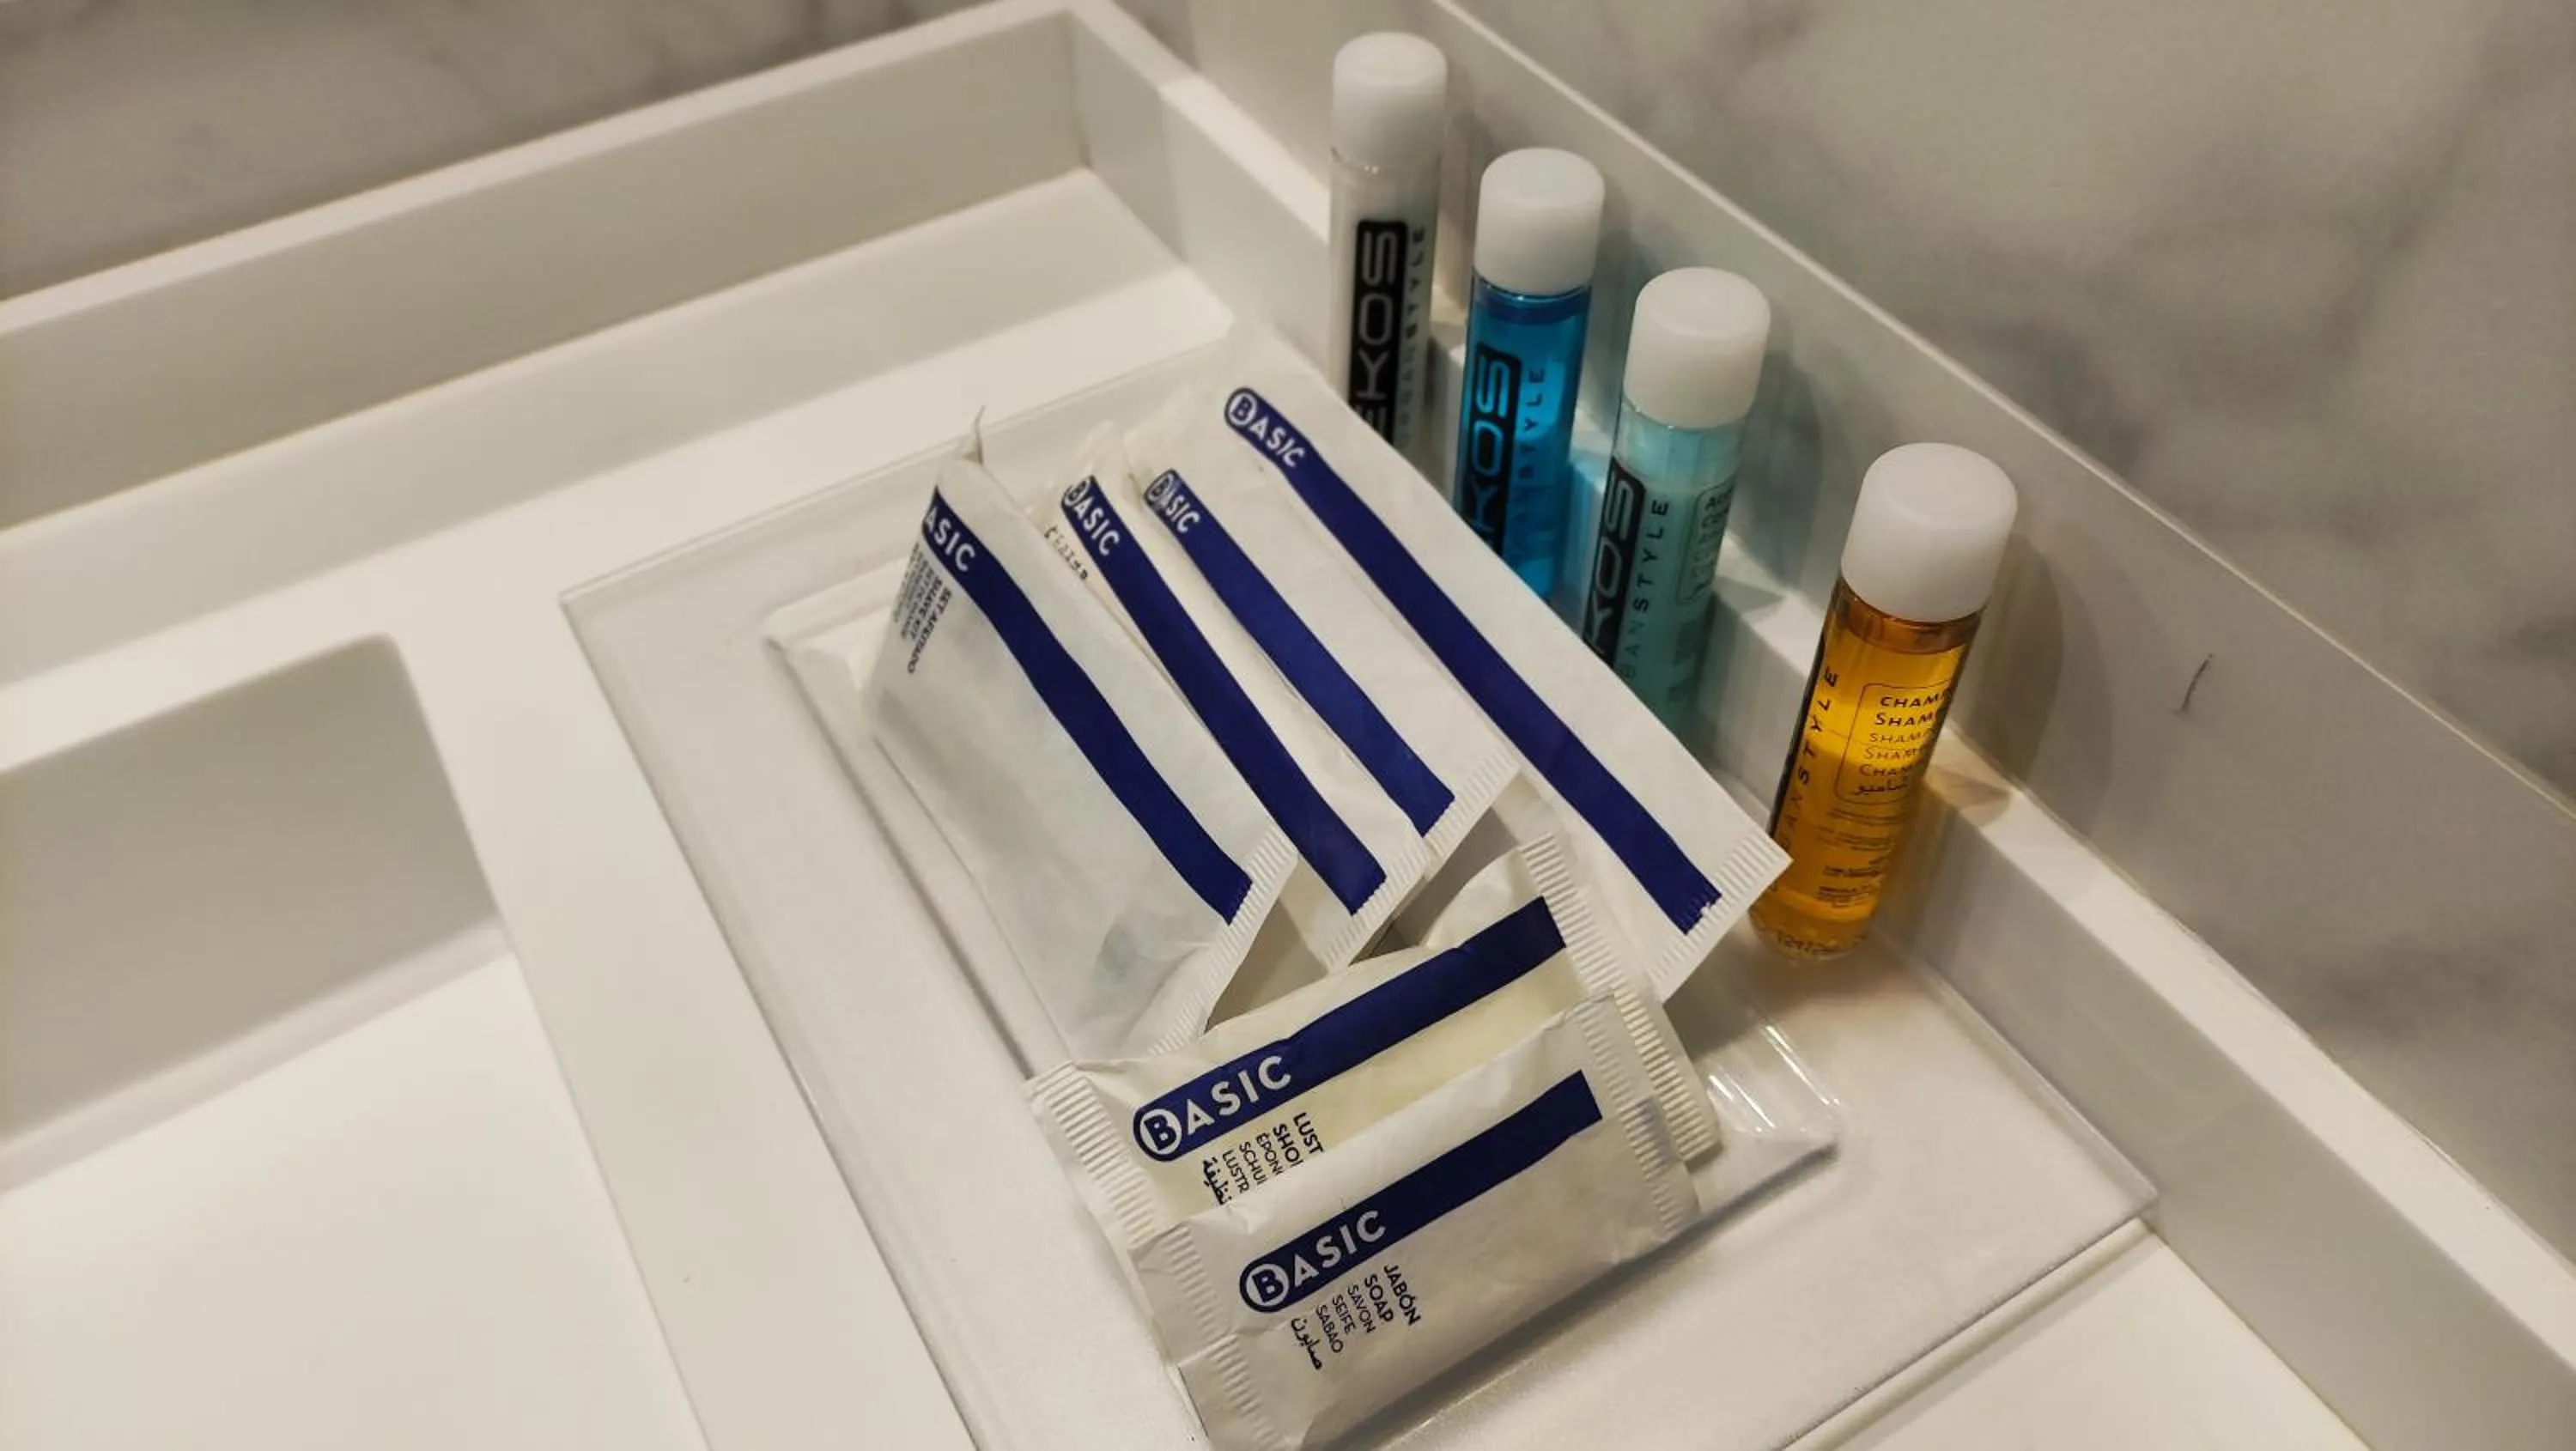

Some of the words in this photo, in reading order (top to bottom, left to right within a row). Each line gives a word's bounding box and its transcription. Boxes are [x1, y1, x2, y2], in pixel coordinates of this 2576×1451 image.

[1228, 392, 1305, 468] BASIC
[1467, 353, 1510, 534] KOS
[1062, 477, 1120, 556] BASIC
[1144, 472, 1200, 533] BASIC
[925, 505, 975, 572] ASIC
[1592, 472, 1635, 656] KOS
[1874, 711, 1937, 726] SHAM
[1139, 1054, 1291, 1157] BASIC
[1245, 1210, 1387, 1314] BASIC
[1332, 1294, 1357, 1335] SEIFE
[1347, 1284, 1376, 1333] SAVON
[1364, 1273, 1394, 1323] SOAP
[1383, 1264, 1421, 1327] JABÓN
[1290, 1317, 1323, 1370] صابون
